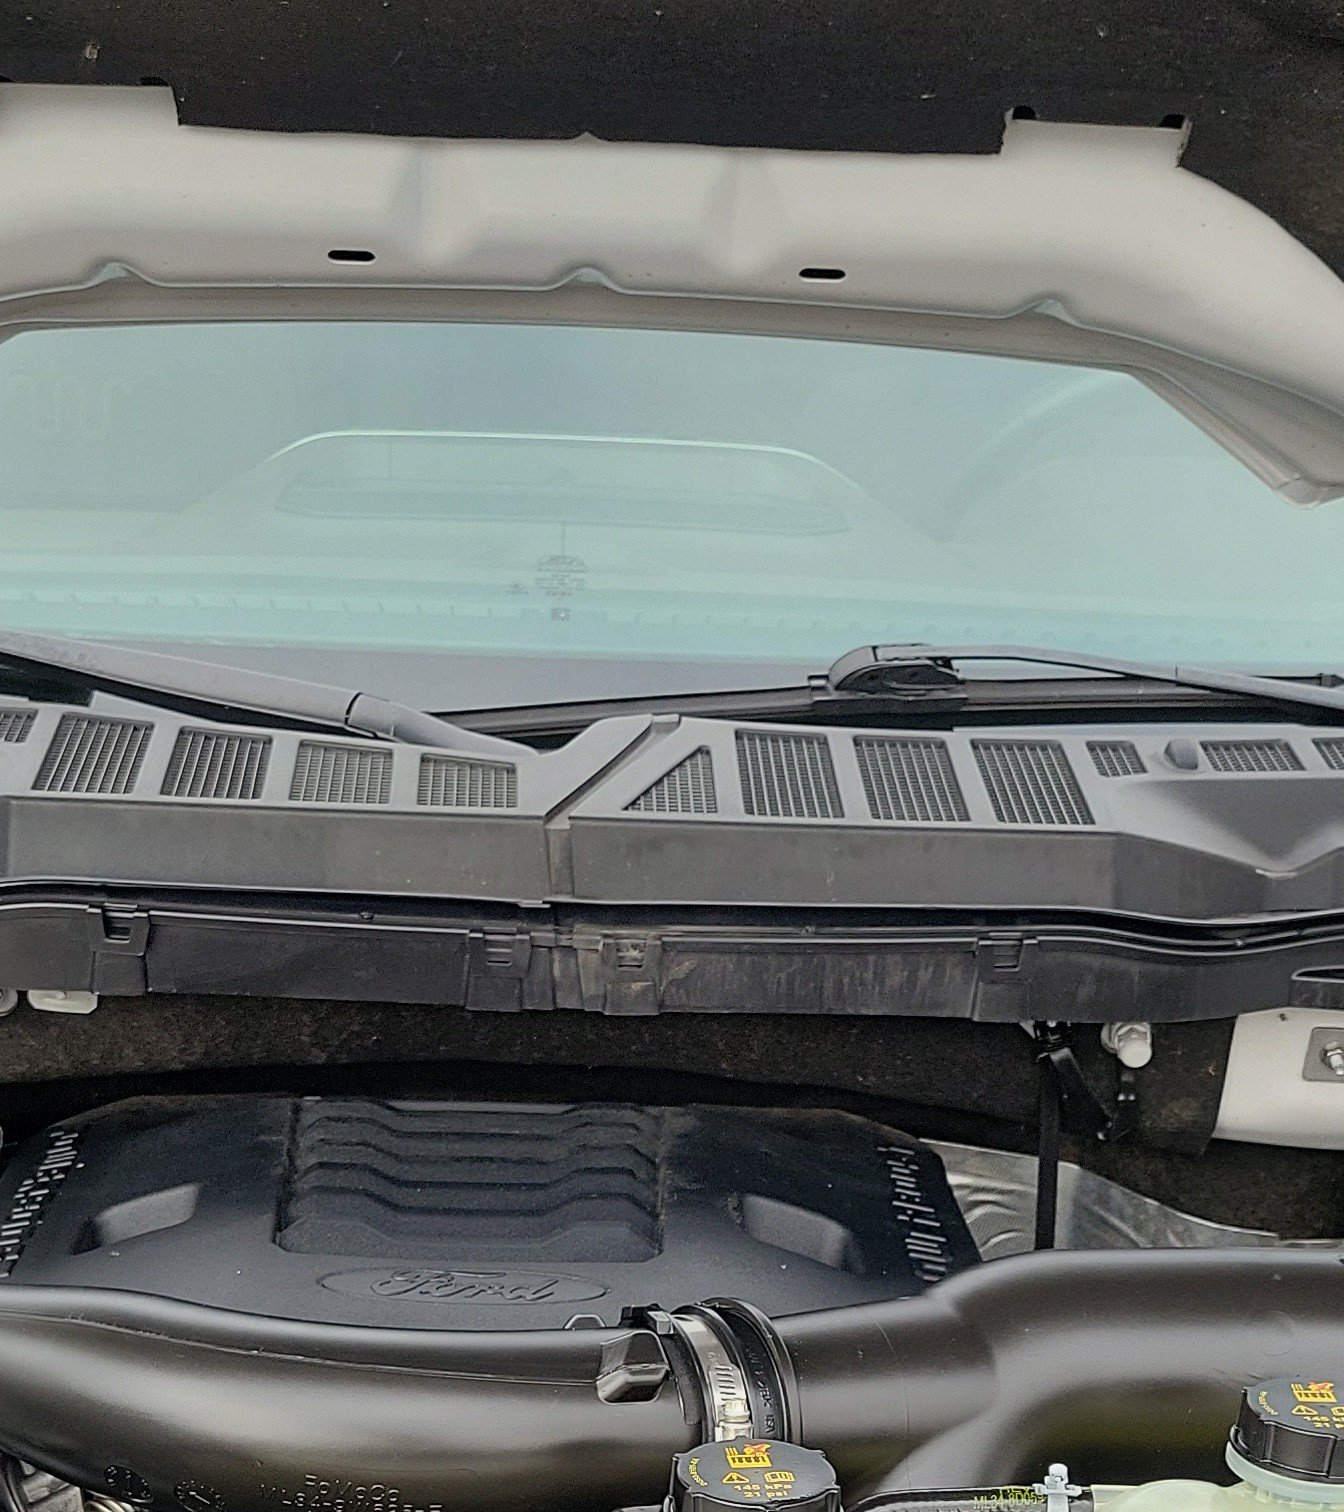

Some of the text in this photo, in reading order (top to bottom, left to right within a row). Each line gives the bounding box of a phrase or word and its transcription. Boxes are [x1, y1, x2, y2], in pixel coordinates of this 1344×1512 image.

[369, 1268, 560, 1302] Ford
[743, 1490, 789, 1499] 21 psi
